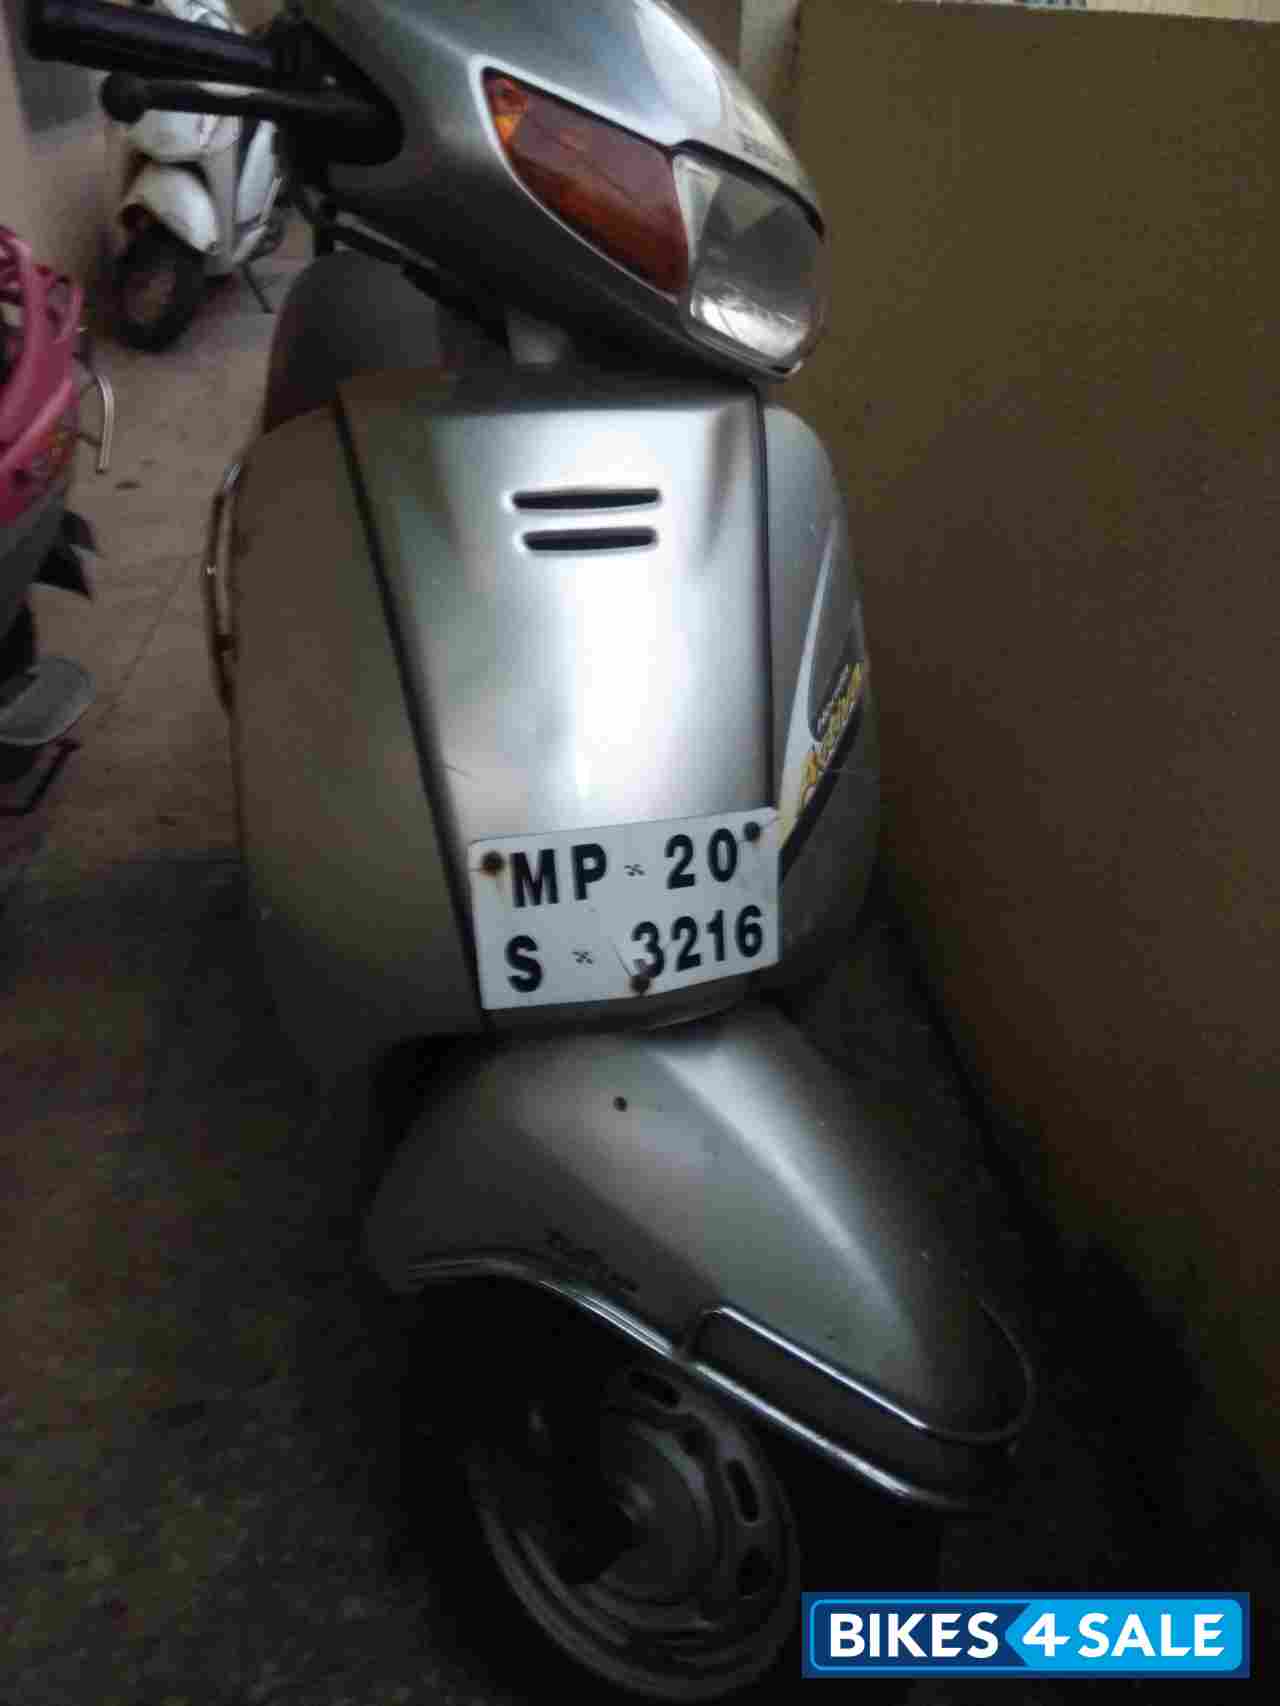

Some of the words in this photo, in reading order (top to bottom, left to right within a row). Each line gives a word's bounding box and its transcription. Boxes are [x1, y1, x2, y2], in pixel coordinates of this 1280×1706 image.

[510, 843, 607, 908] MP
[665, 827, 739, 890] 20
[504, 934, 544, 994] S
[629, 904, 764, 980] 3216
